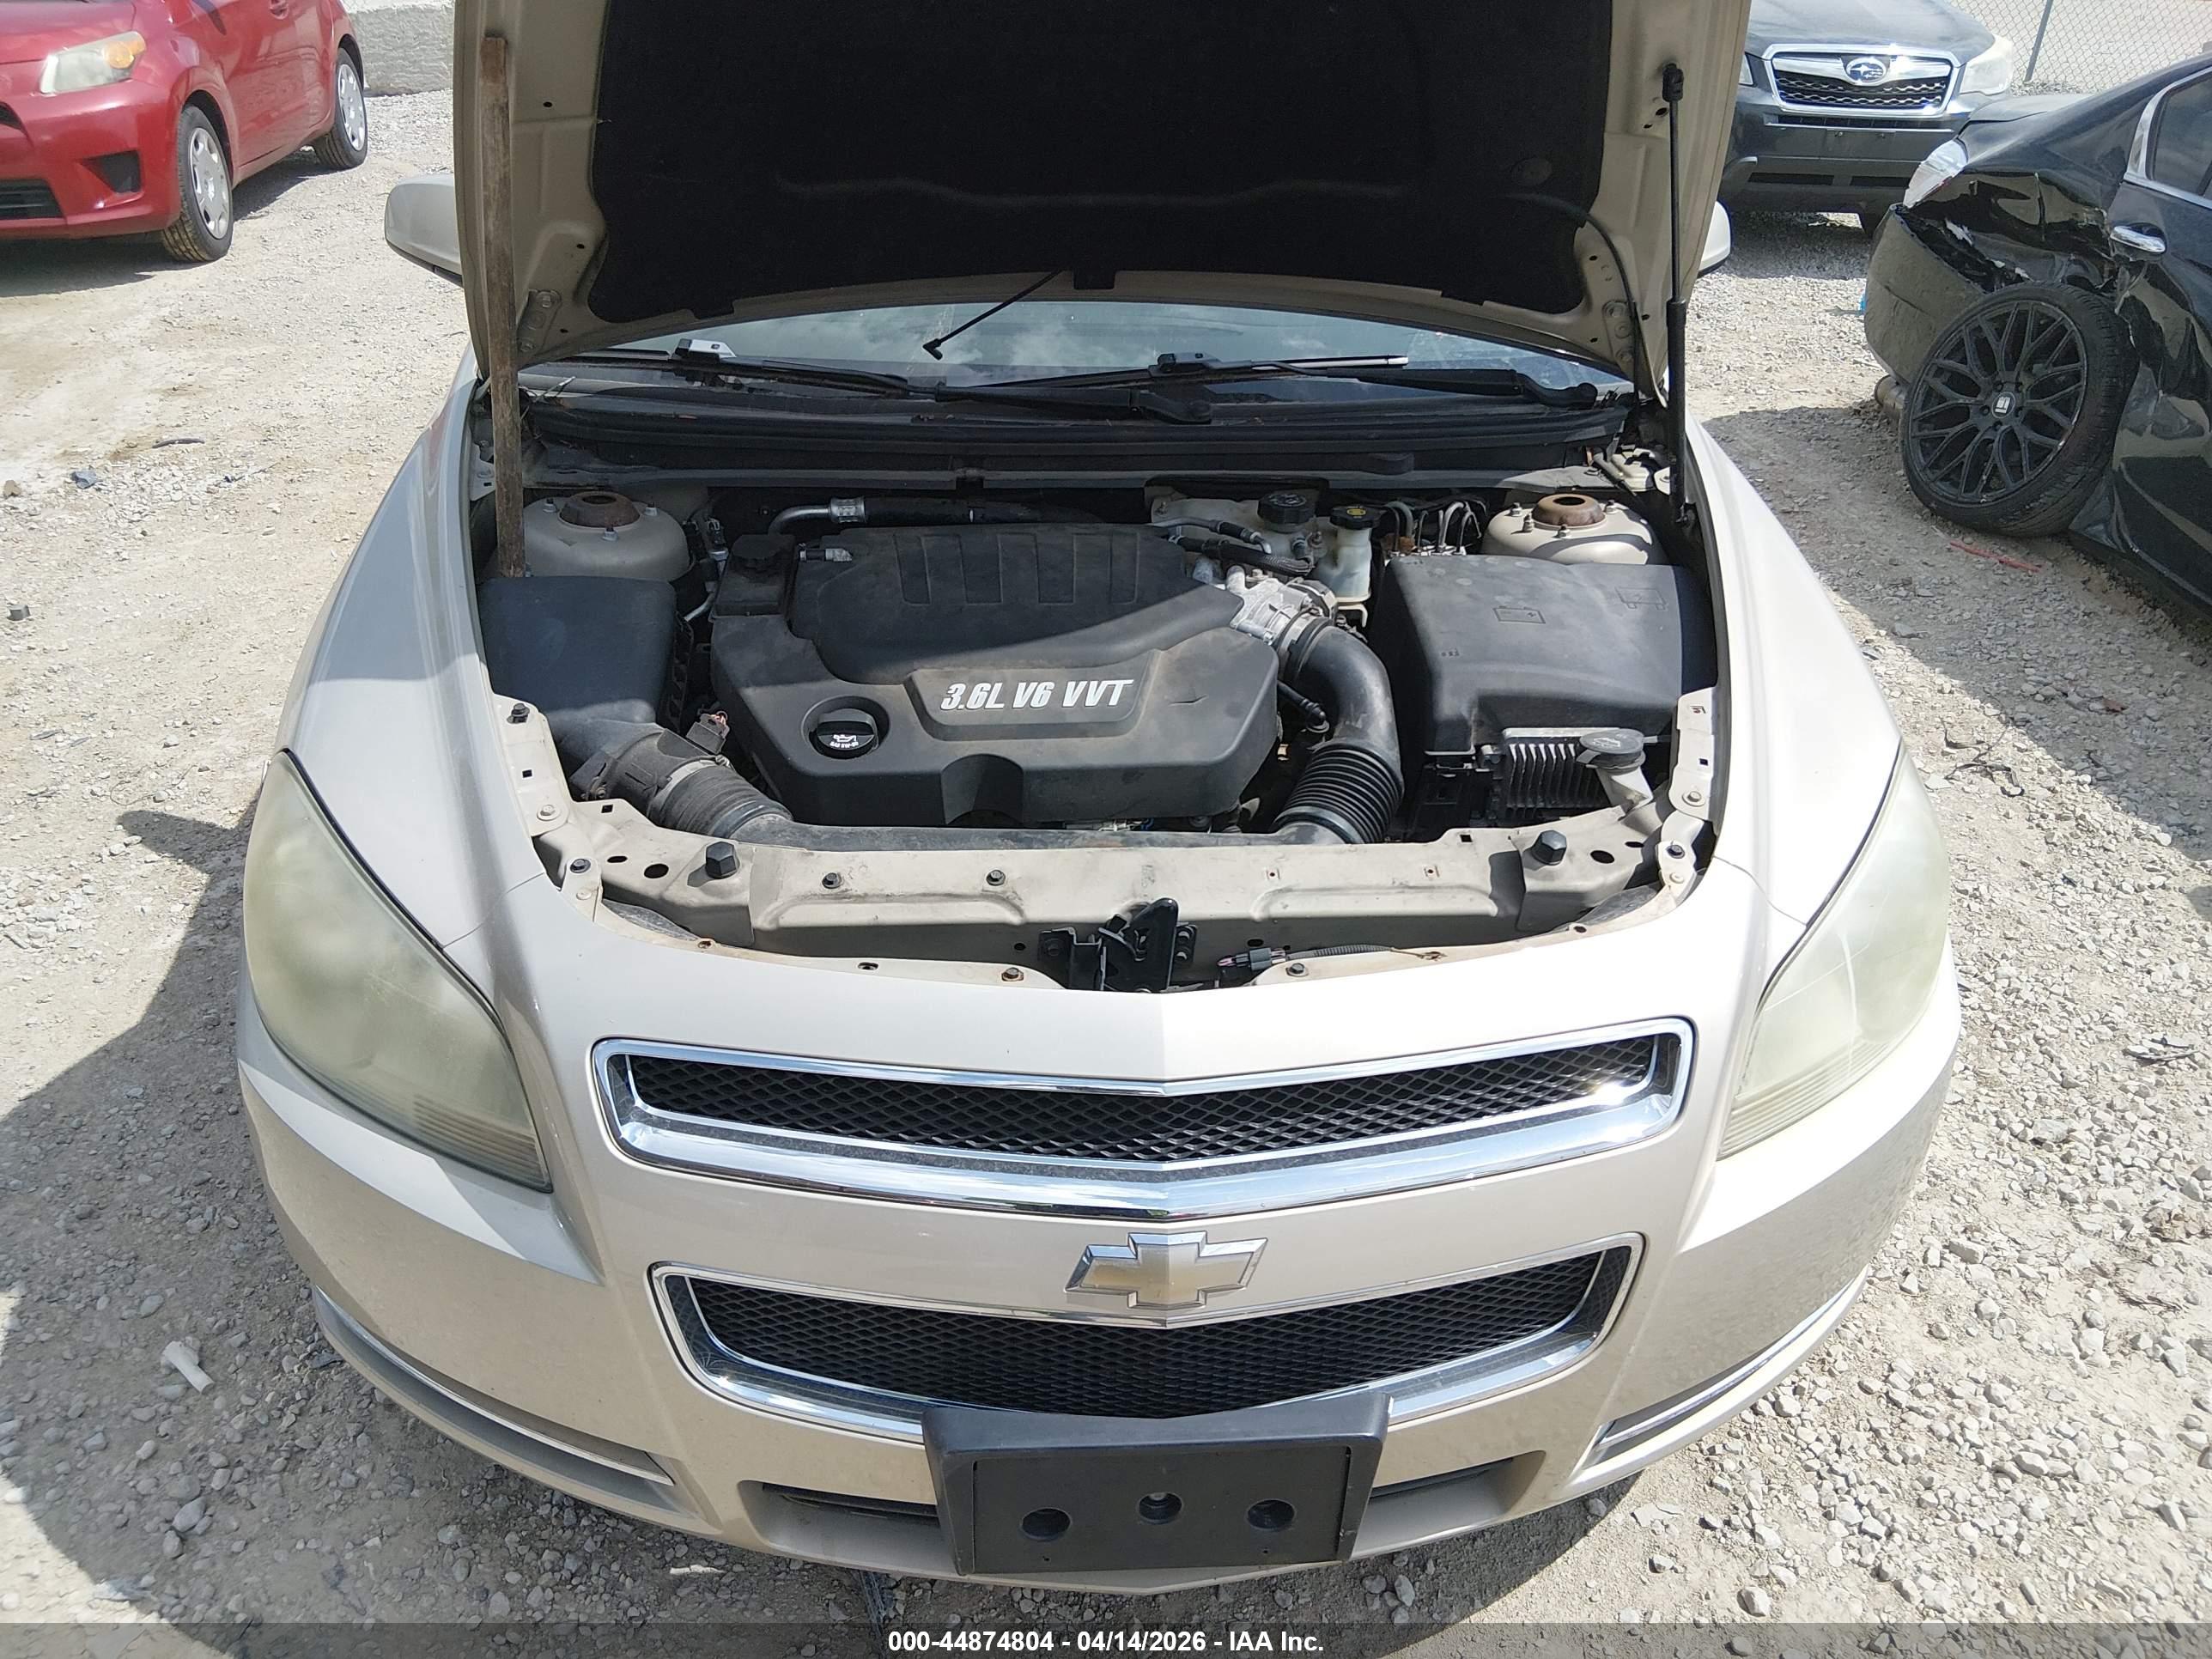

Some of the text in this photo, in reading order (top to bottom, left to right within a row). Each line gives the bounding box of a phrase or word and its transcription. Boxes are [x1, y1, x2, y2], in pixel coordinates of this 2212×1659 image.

[940, 678, 1134, 710] 3.6L V6 VVT
